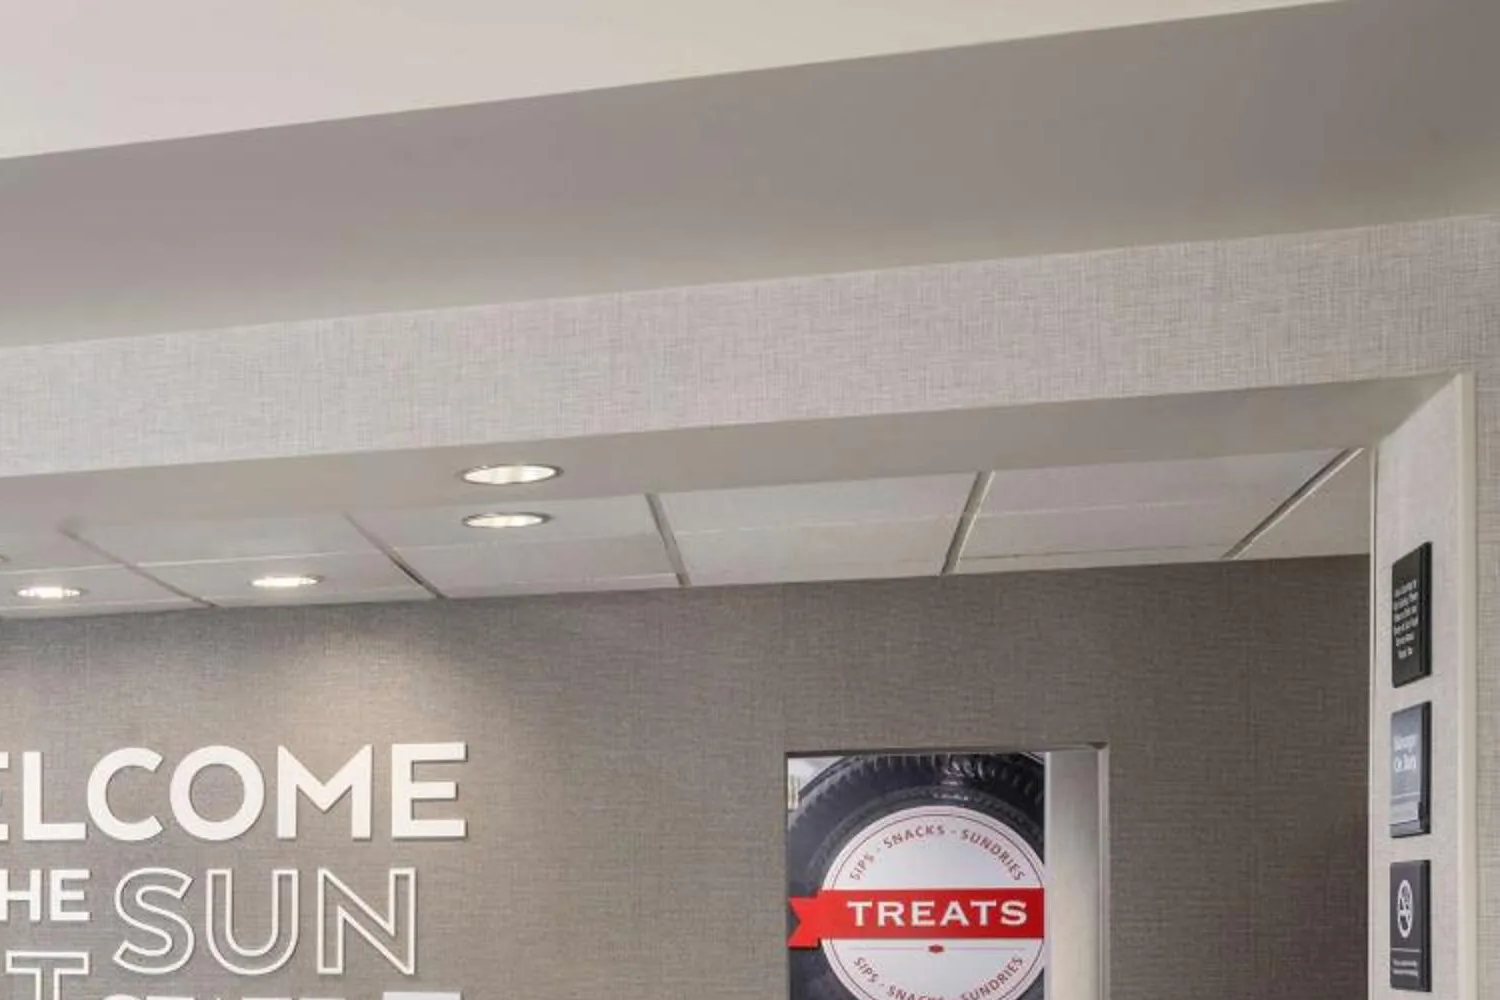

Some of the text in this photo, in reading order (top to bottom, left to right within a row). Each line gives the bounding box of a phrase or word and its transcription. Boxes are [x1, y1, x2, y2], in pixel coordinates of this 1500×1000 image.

[849, 824, 1026, 882] SIPS SNACKS SUNDRIES
[112, 867, 416, 975] SUN
[846, 898, 1028, 928] TREATS
[853, 956, 880, 983] SIPS
